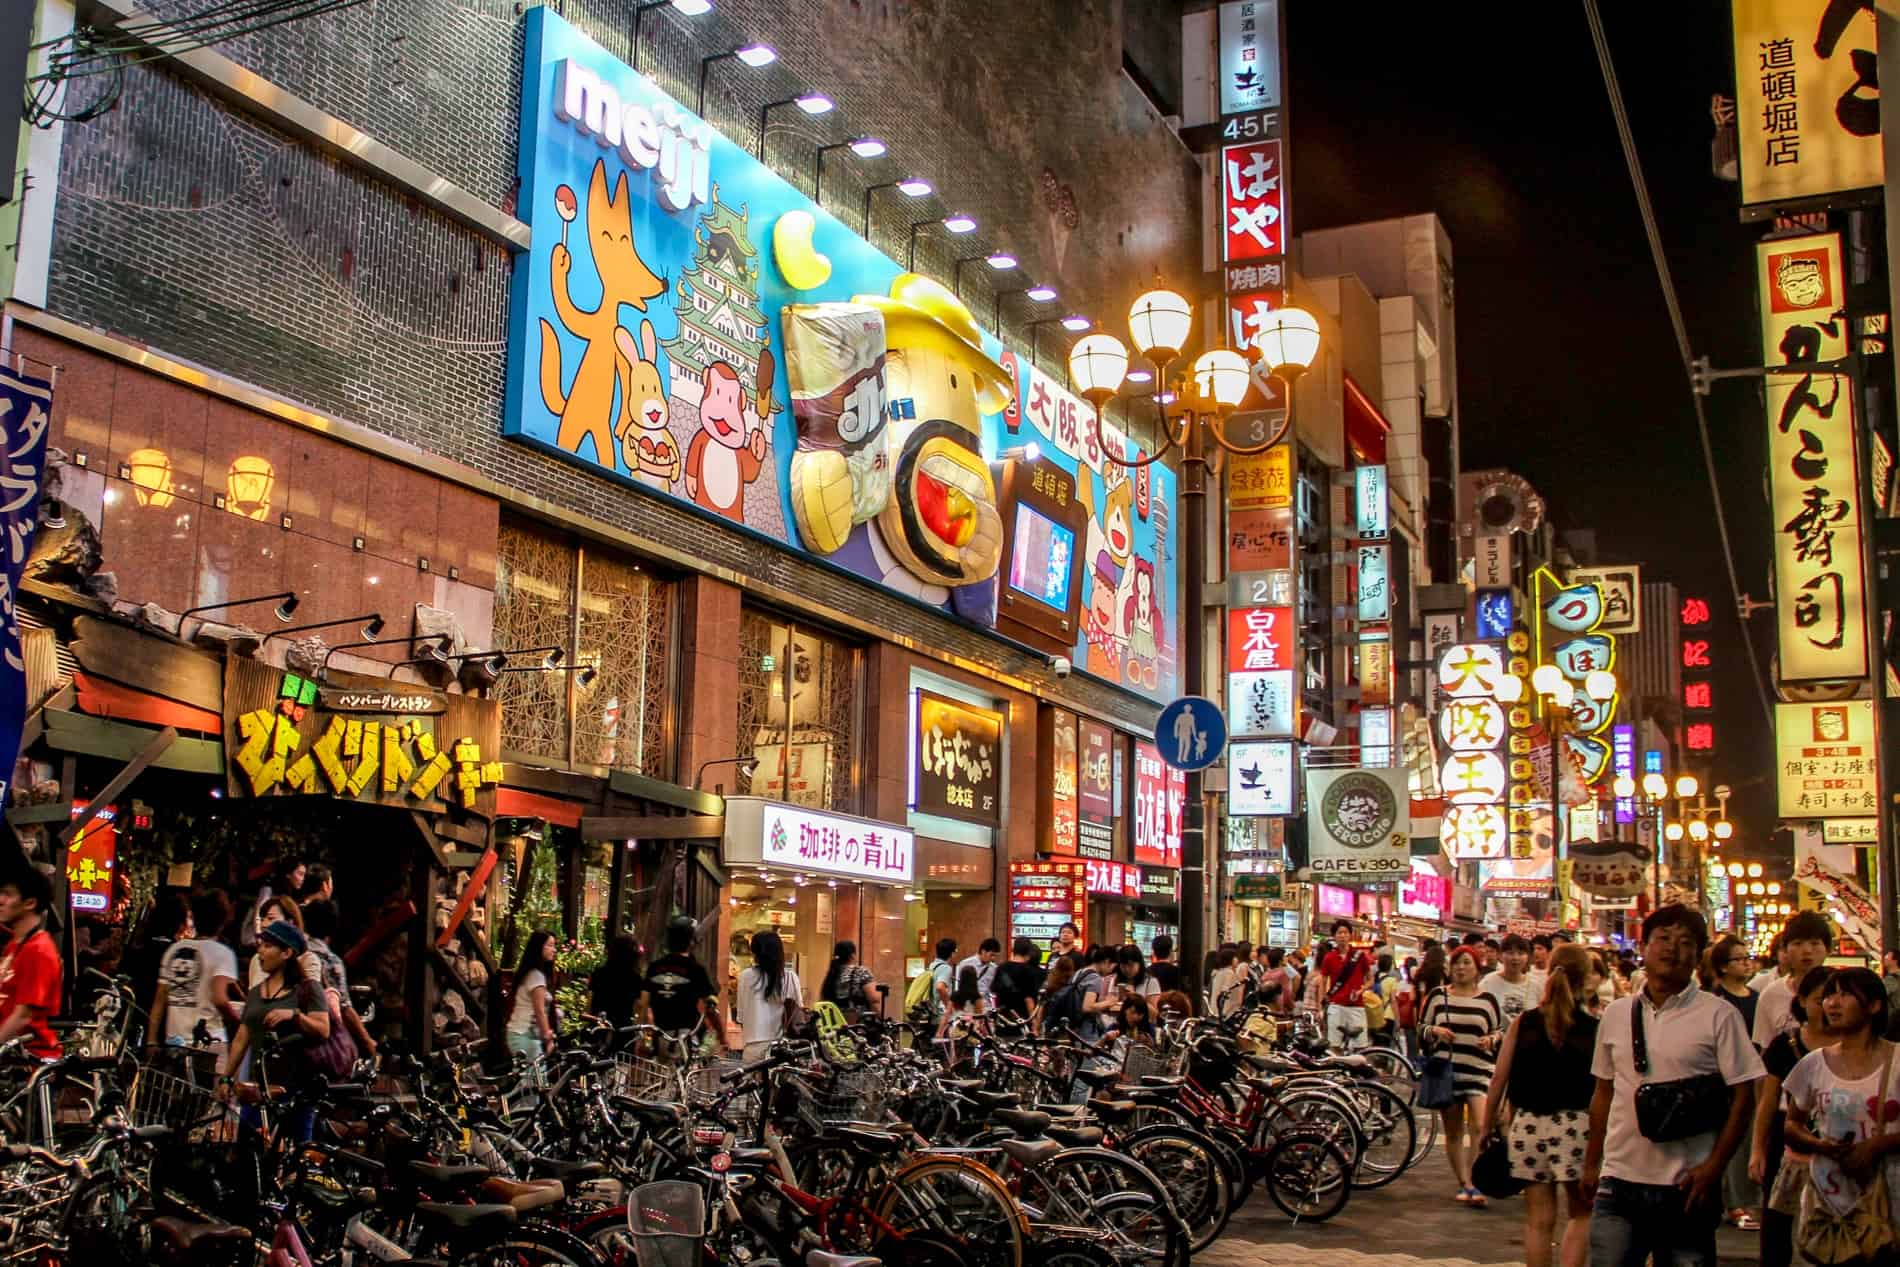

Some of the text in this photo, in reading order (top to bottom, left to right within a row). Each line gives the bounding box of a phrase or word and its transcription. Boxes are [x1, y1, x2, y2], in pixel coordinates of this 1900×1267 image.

[1758, 37, 1800, 168] 道頓堀店
[554, 58, 711, 212] meiji
[1228, 152, 1281, 250] はや
[1230, 264, 1281, 291] 焼肉
[1252, 579, 1289, 604] 2F
[1242, 610, 1280, 669] 白木屋
[339, 693, 432, 711] ハンバーグレストラン
[236, 673, 504, 808] びっくりドンキー
[1440, 646, 1499, 868] 大阪王将
[1797, 792, 1876, 810] 寿司・和食
[799, 821, 905, 873] 珈琲の青山
[1328, 820, 1361, 845] ZERO
[1086, 860, 1122, 894] 白木屋
[1312, 859, 1357, 871] CAFE
